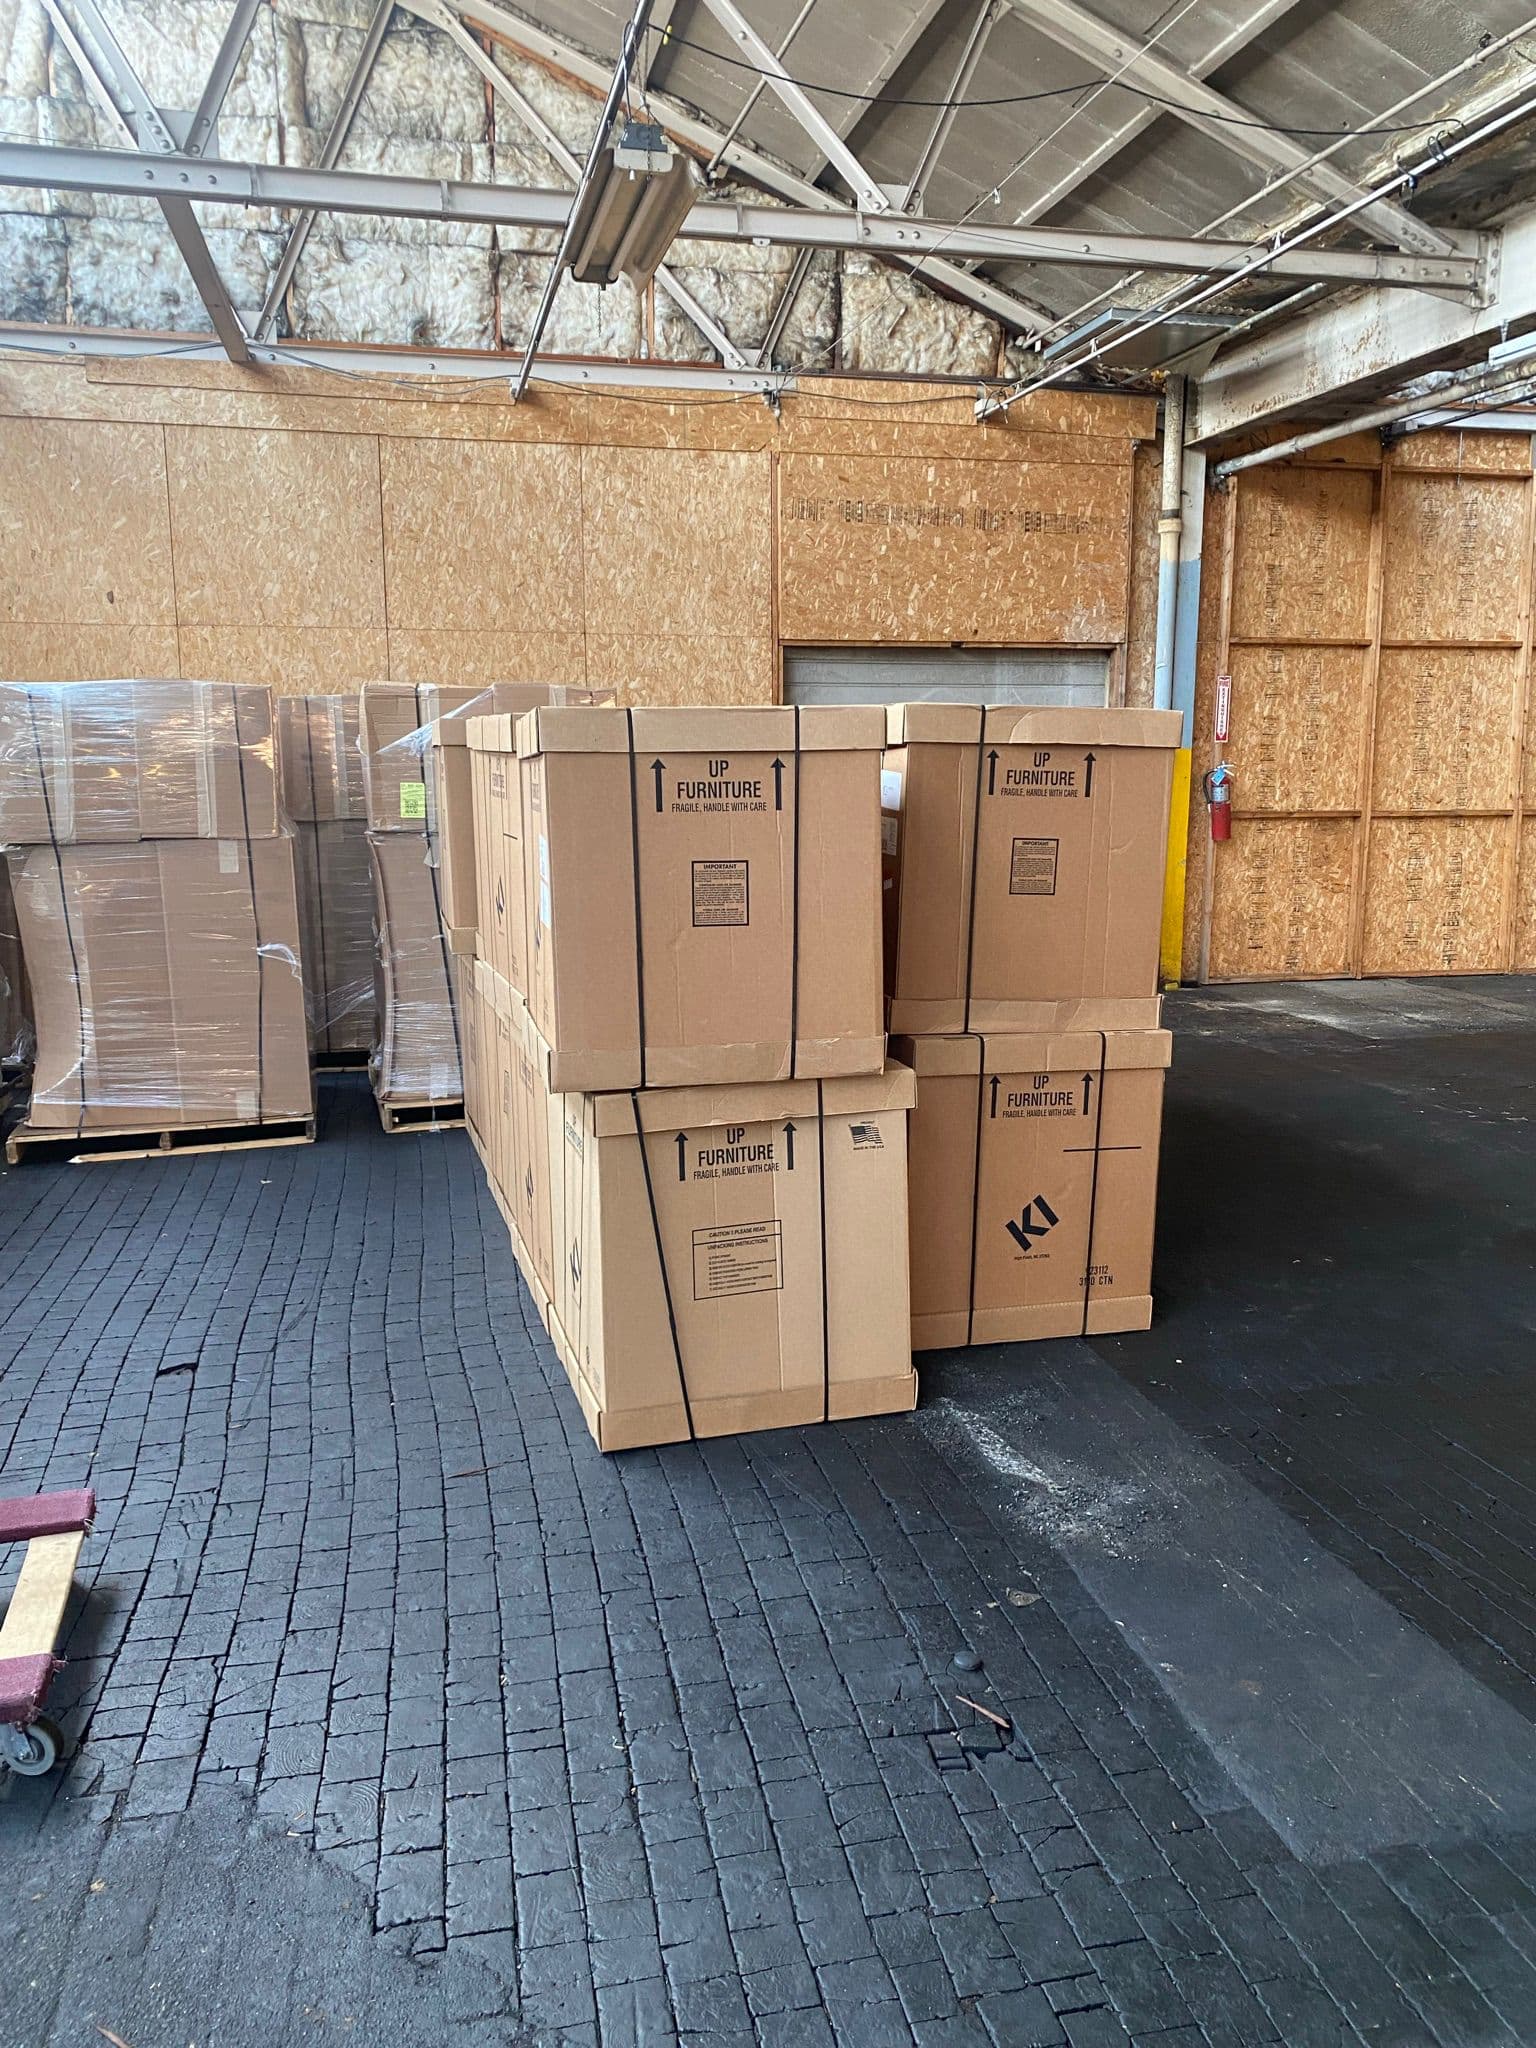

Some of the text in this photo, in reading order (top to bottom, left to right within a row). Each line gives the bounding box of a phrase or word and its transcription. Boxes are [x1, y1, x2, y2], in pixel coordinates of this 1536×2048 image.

[1034, 752, 1050, 768] UP
[708, 760, 729, 778] UP
[1006, 770, 1076, 786] FURNITURE
[677, 781, 762, 799] FURNITURE
[1026, 788, 1048, 798] HANDLE
[1049, 788, 1063, 798] WITH
[1064, 789, 1078, 798] CARE
[672, 802, 768, 814] FRAGILE, HANDLE WITH CARE
[1034, 1076, 1049, 1090] UP
[1008, 1092, 1074, 1107] FURNITURE
[1026, 1109, 1048, 1118] HANDLE
[1048, 1108, 1062, 1116] WITH
[1062, 1108, 1077, 1116] CARE
[727, 1128, 745, 1144] UP
[698, 1144, 774, 1167] FURNITURE
[694, 1162, 780, 1180] FRAGILE, HANDLE WITH CARE
[708, 1230, 730, 1238] CAUTION
[734, 1227, 752, 1235] PLEASE
[707, 1238, 768, 1250] UNPACKING INSTRUCTIONS
[1098, 1276, 1114, 1285] CTN
